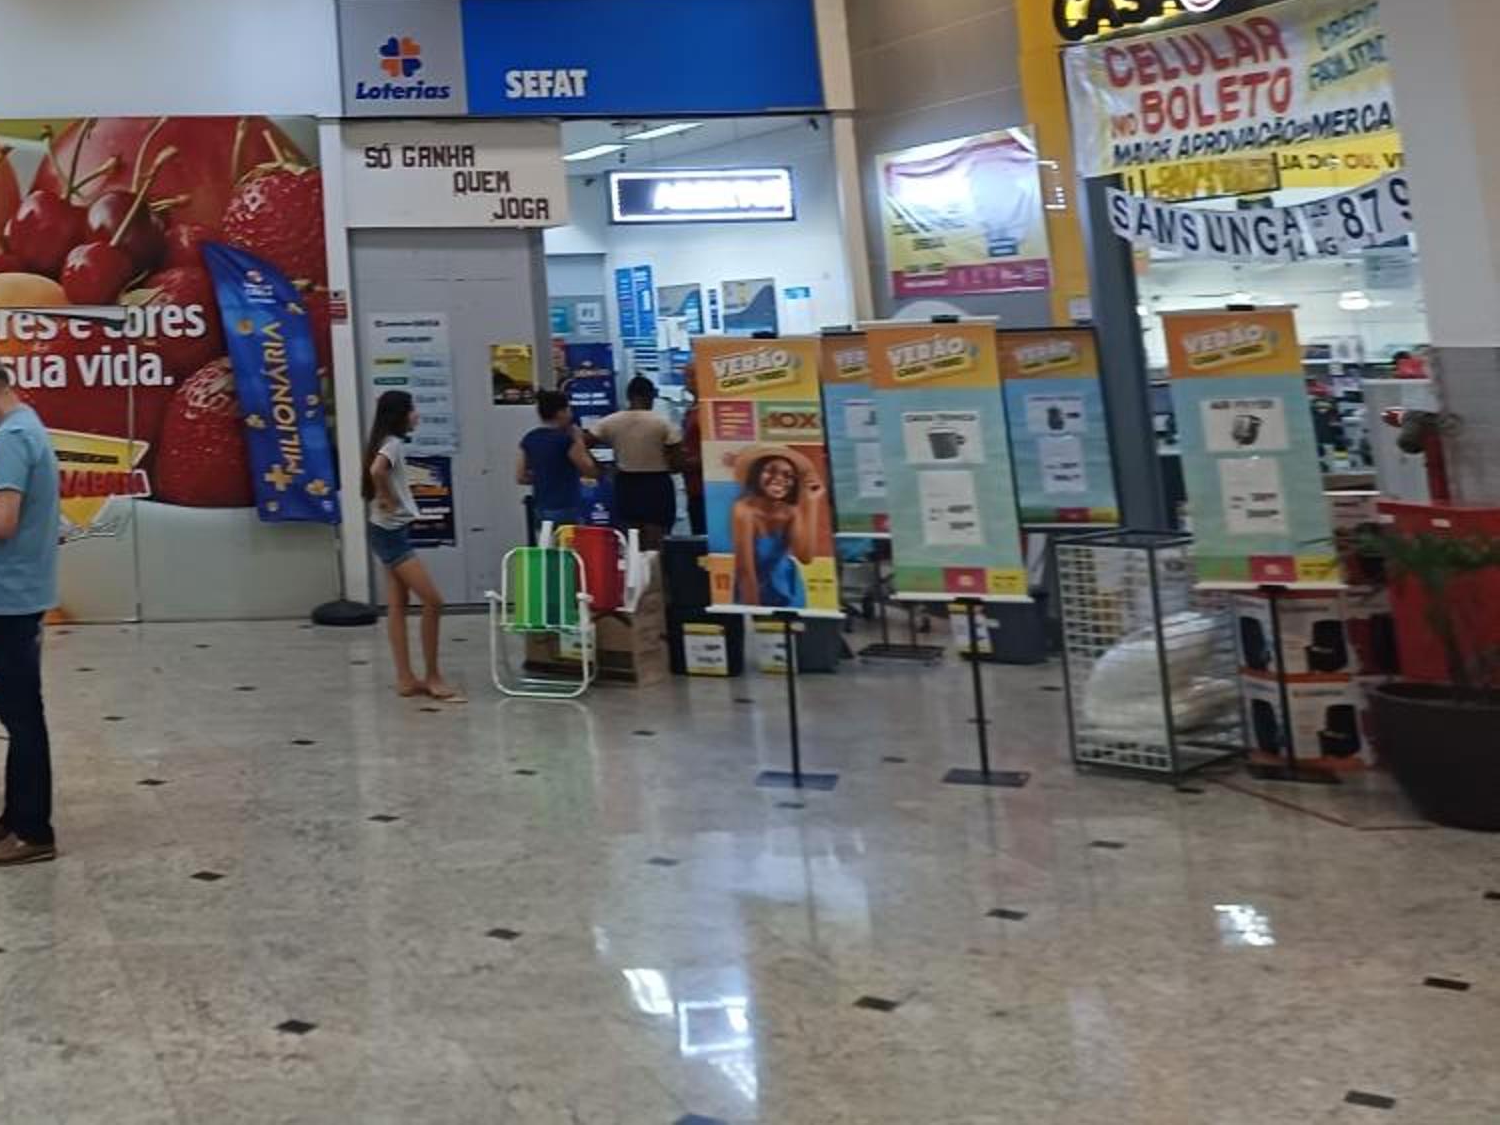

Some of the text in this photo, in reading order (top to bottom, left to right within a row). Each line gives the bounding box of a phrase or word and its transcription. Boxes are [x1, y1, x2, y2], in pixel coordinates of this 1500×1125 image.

[1104, 16, 1288, 88] CELULAR
[355, 69, 588, 100] Loterias SEFAT
[1111, 67, 1293, 138] NO BOLETO
[364, 143, 475, 169] SÓ GANHA
[453, 171, 511, 194] QUEM
[493, 198, 549, 220] JOGA
[1112, 194, 1279, 256] SAMSUNG
[713, 347, 790, 378] VERÃO
[887, 334, 966, 365] VERÃO
[8, 353, 67, 388] sua
[76, 345, 174, 387] vida.
